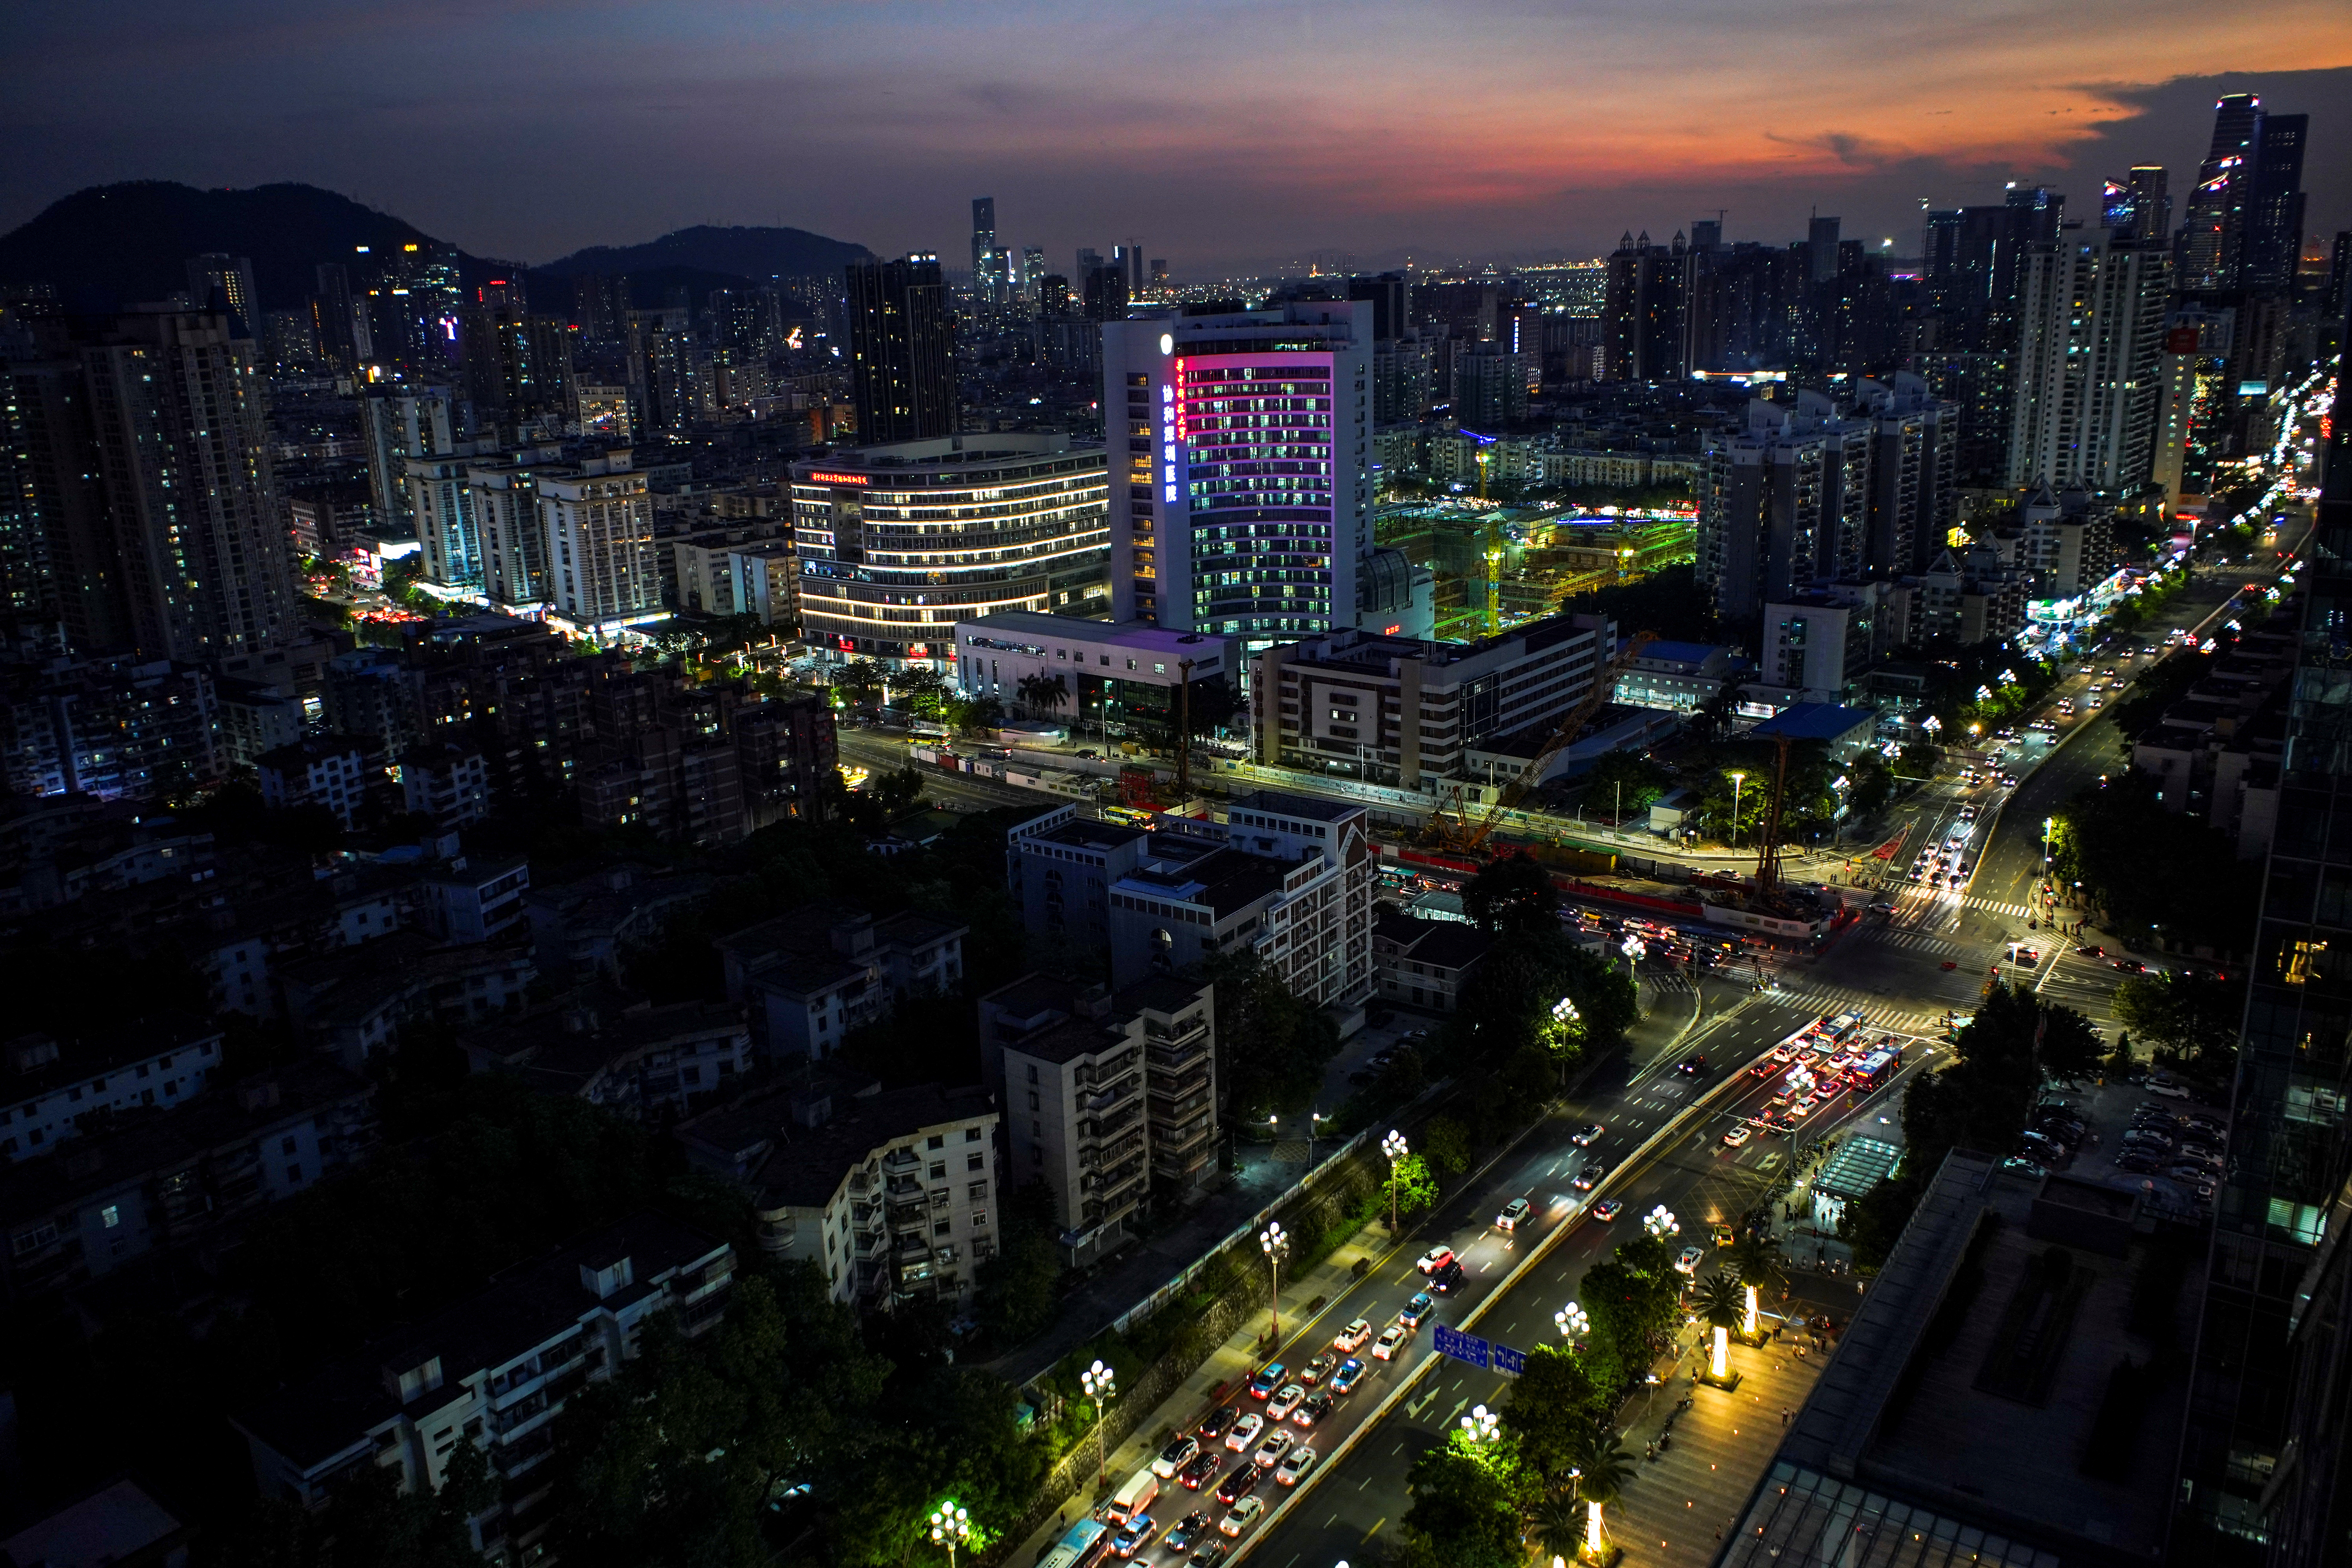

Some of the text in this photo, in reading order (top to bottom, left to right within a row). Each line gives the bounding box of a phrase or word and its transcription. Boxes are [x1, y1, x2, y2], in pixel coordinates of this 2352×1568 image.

[1163, 385, 1177, 503] 协和深圳医院
